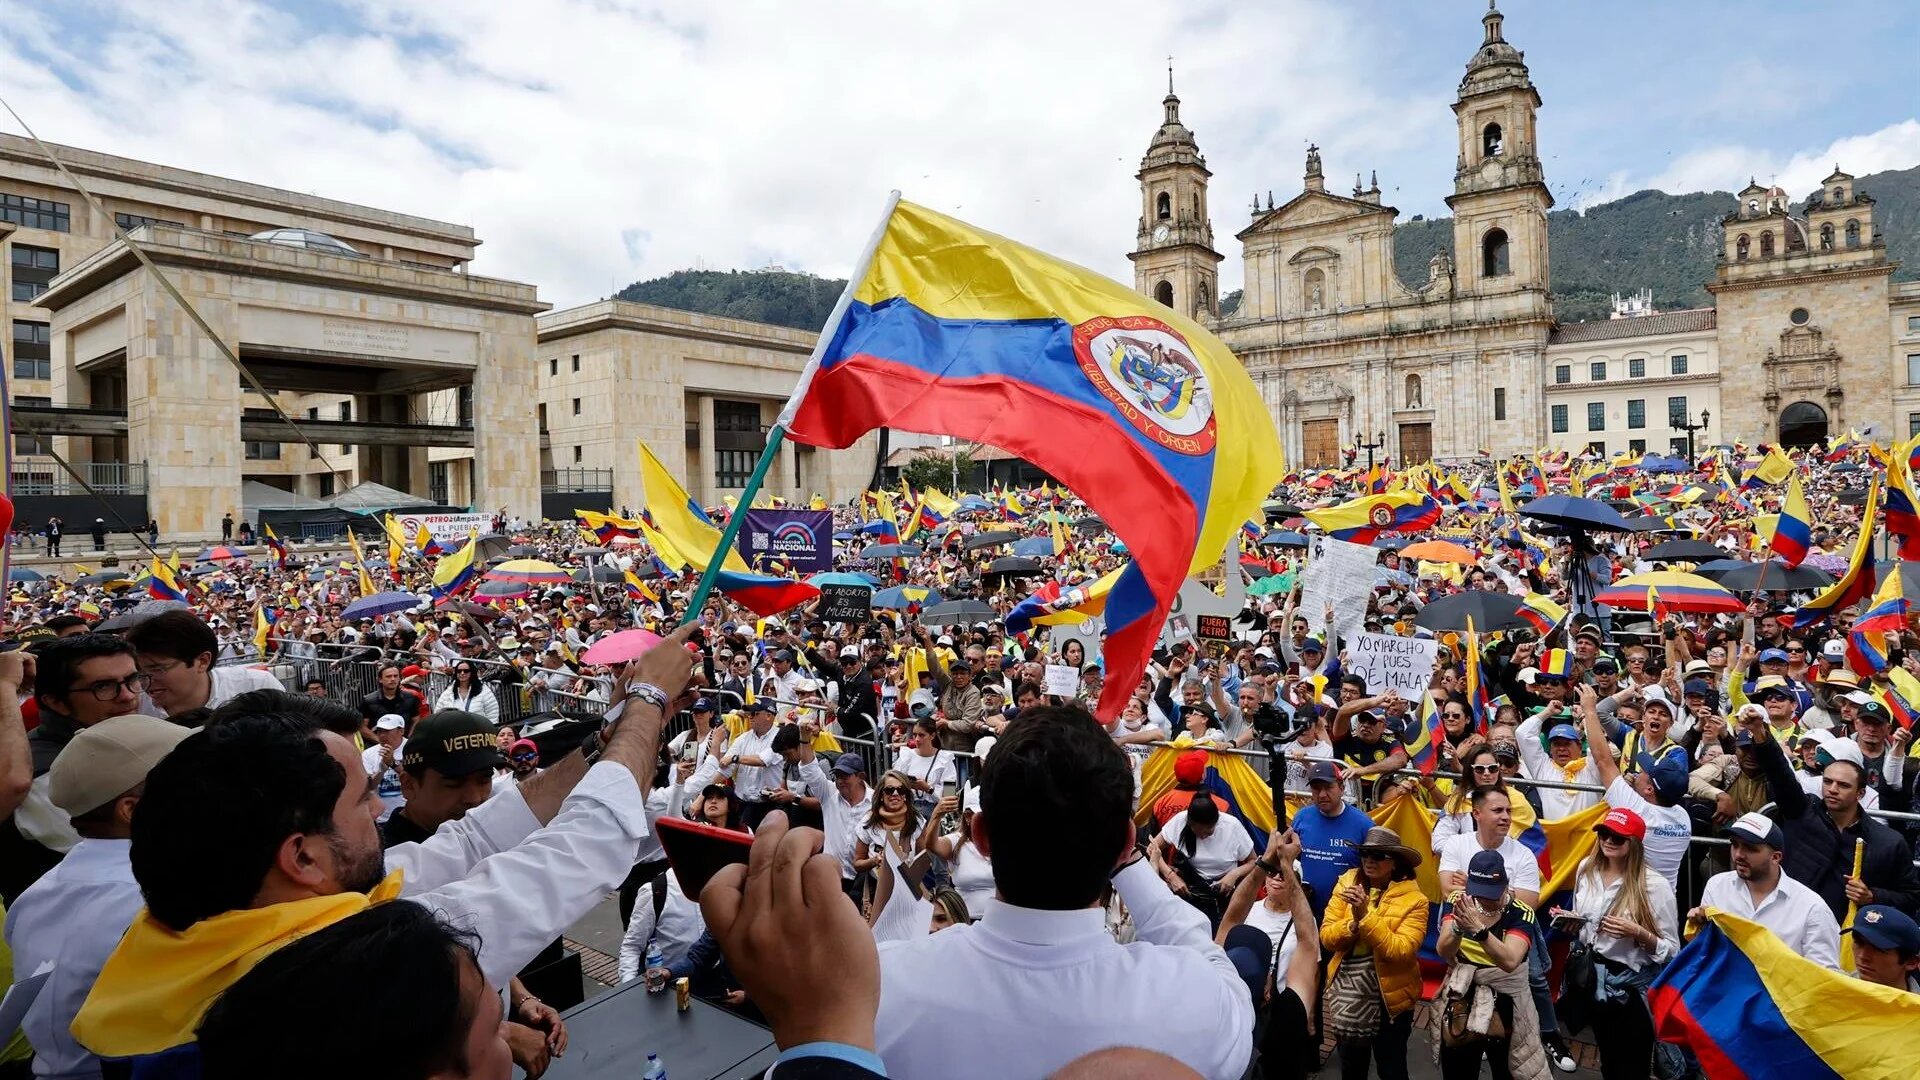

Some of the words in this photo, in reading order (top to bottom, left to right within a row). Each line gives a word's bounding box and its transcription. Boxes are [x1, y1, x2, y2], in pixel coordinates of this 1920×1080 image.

[1083, 362, 1139, 420] LIBERTAD
[1143, 421, 1154, 434] Y
[1158, 430, 1201, 452] ORDEN
[773, 544, 817, 552] NACIONAL
[835, 588, 869, 598] ABORTO
[837, 597, 849, 607] ES
[825, 607, 865, 618] MUERTE
[1201, 617, 1228, 628] FUERA
[1200, 626, 1227, 637] PETRO
[1357, 636, 1372, 652] YO
[1373, 638, 1425, 655] MARCHO
[1368, 654, 1377, 667] Y
[1383, 655, 1412, 669] PUES
[1354, 665, 1382, 687] DE
[1654, 827, 1677, 837] EDWIN
